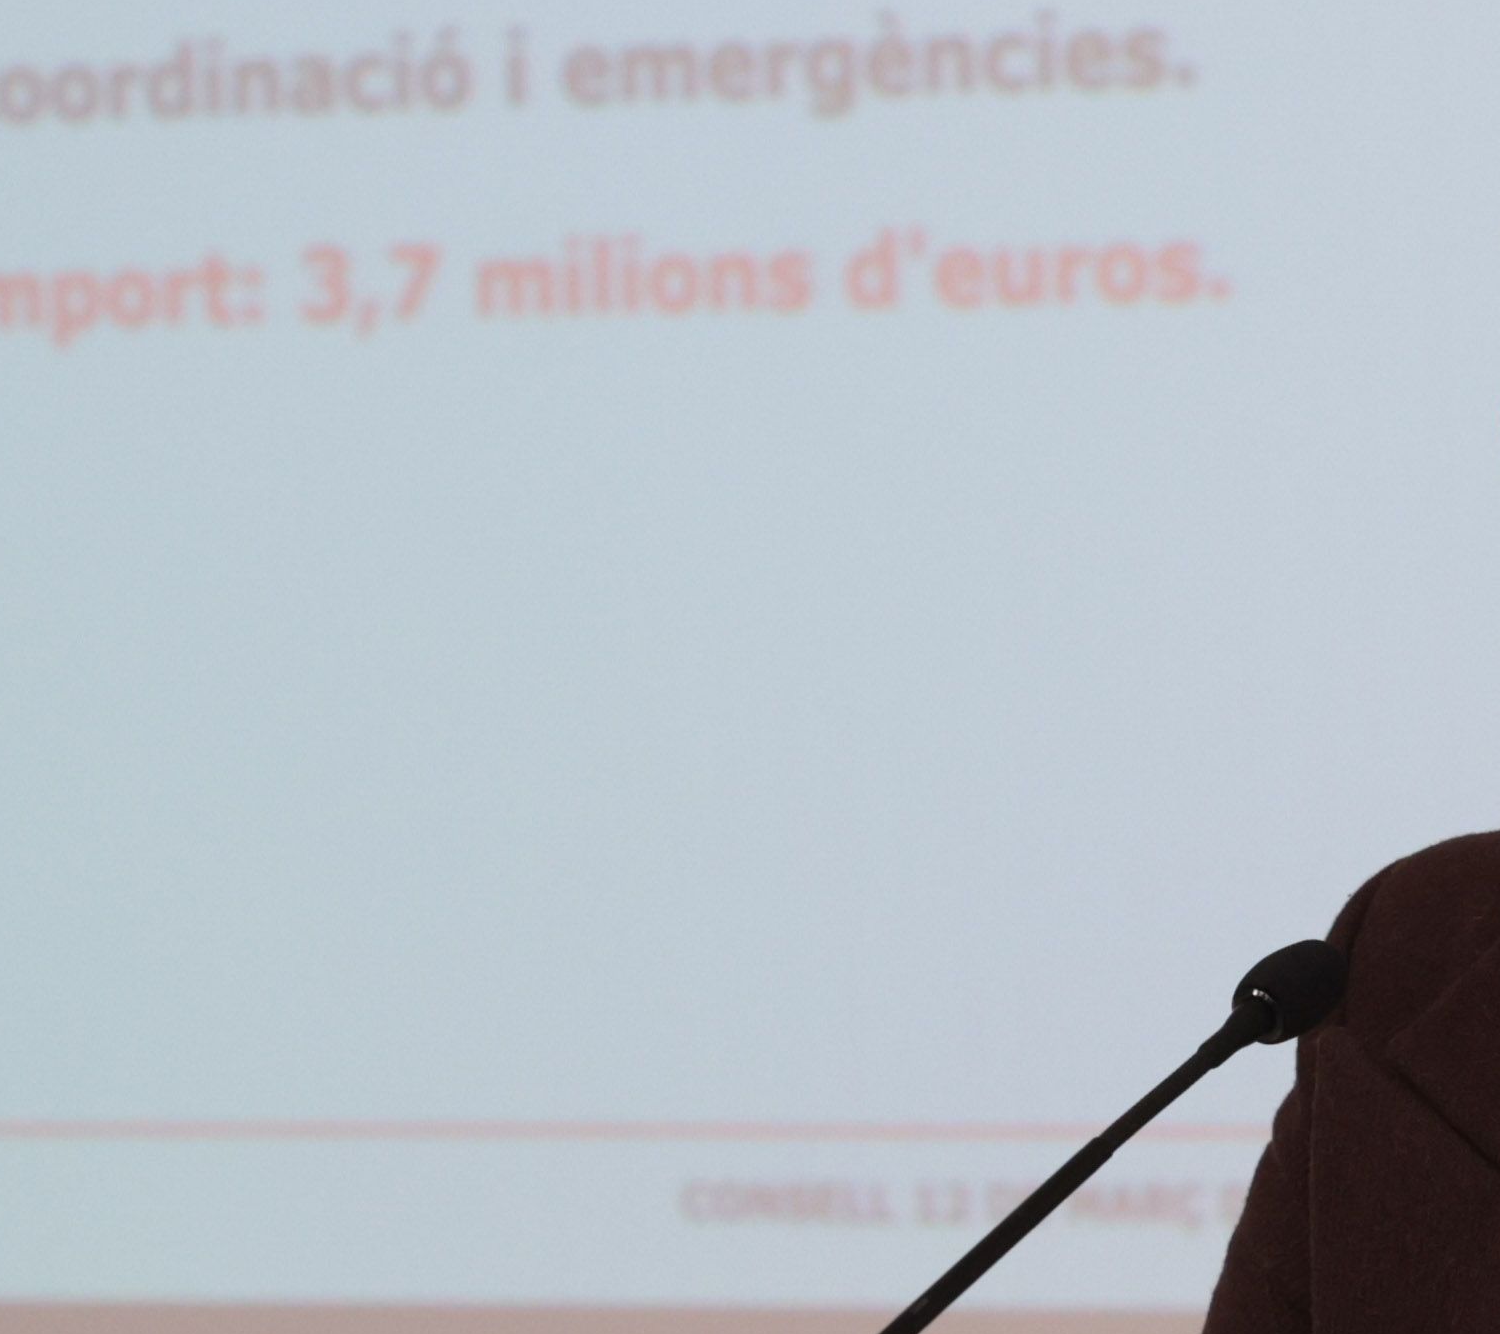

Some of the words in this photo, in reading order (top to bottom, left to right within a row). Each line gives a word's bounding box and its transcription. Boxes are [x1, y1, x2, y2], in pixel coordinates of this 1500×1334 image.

[503, 26, 530, 106] i
[558, 9, 1198, 119] emergències.
[300, 247, 443, 335] 3,7
[474, 232, 817, 317] milions
[842, 225, 1233, 310] d'euros.
